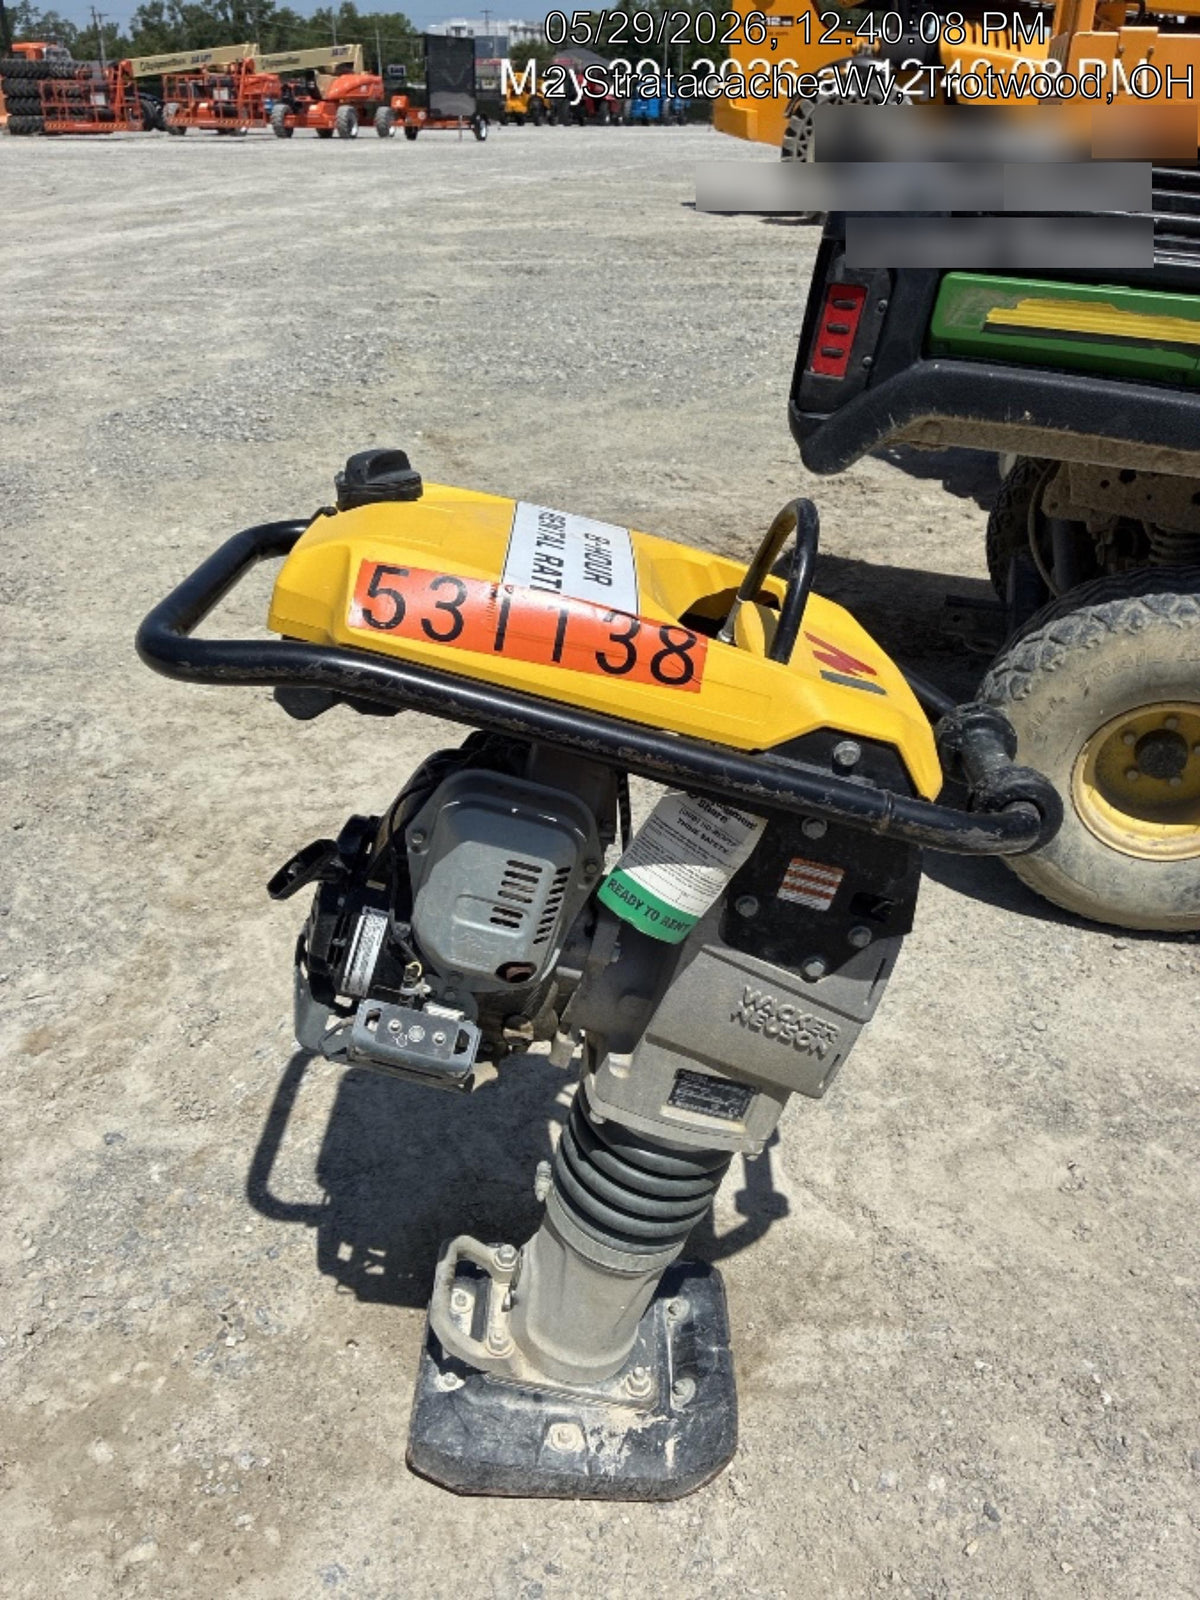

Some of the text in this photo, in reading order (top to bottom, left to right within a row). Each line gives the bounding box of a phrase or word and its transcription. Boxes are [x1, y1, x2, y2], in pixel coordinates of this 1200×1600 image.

[362, 564, 698, 686] 531138
[700, 832, 729, 854] SAFETY
[608, 878, 692, 932] READY TO RENT
[730, 1001, 827, 1060] NEUSON
[743, 985, 840, 1044] WACKER
